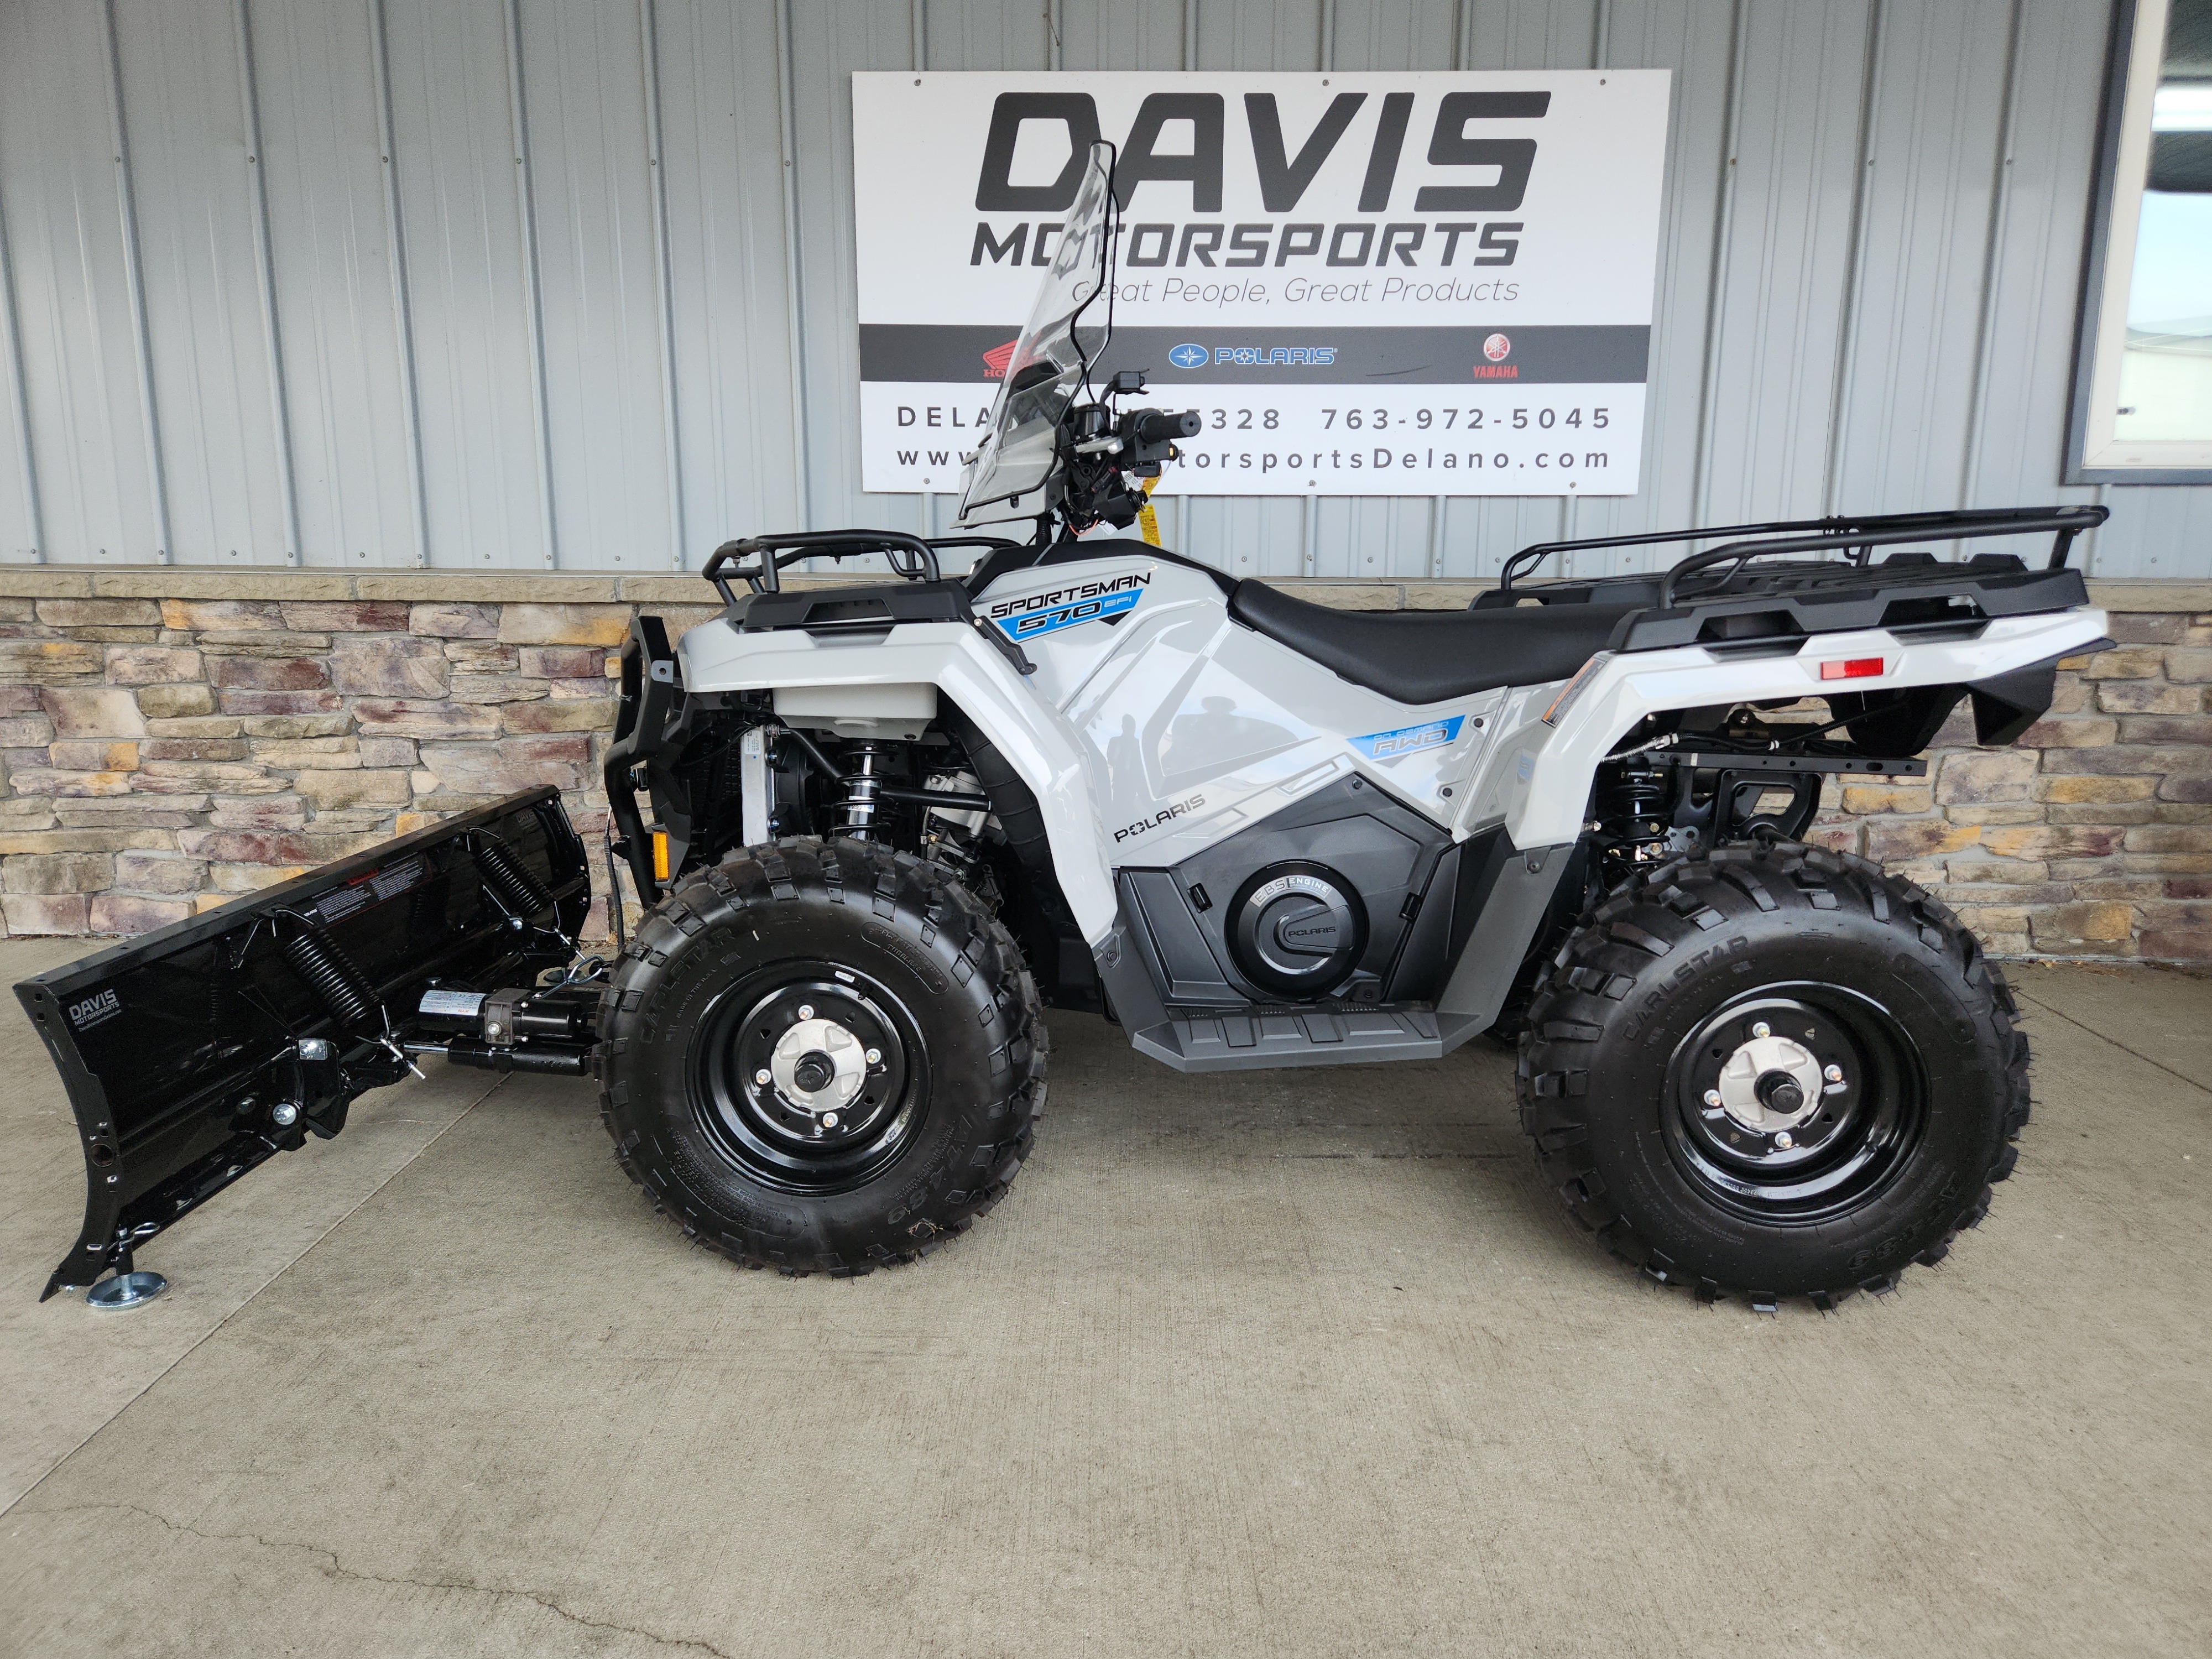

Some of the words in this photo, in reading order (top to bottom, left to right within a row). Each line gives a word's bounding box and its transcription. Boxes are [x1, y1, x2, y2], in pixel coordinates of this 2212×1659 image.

[975, 91, 1552, 212] DAVIS
[970, 222, 1524, 267] MOTORSPORTS
[1162, 276, 1271, 308] People,
[1284, 277, 1373, 303] Great
[1382, 276, 1520, 304] Products
[1473, 365, 1519, 379] YAMAHA
[897, 406, 991, 427] DELA
[1163, 408, 1280, 430] 328
[1321, 407, 1611, 430] 763-972-5045
[990, 572, 1151, 619] SPORTSMAN
[1016, 601, 1102, 634] 570
[1104, 596, 1133, 608] EFI
[1373, 728, 1449, 755] AWD
[1113, 793, 1207, 843] POLARIS
[1254, 879, 1286, 903] EBS
[1288, 878, 1329, 893] ENGINE
[1288, 926, 1336, 937] POLARIS
[69, 988, 117, 1020] DAVIS
[1622, 935, 1749, 1041] CARLSTAR
[74, 1001, 119, 1026] MOTORSPORTS
